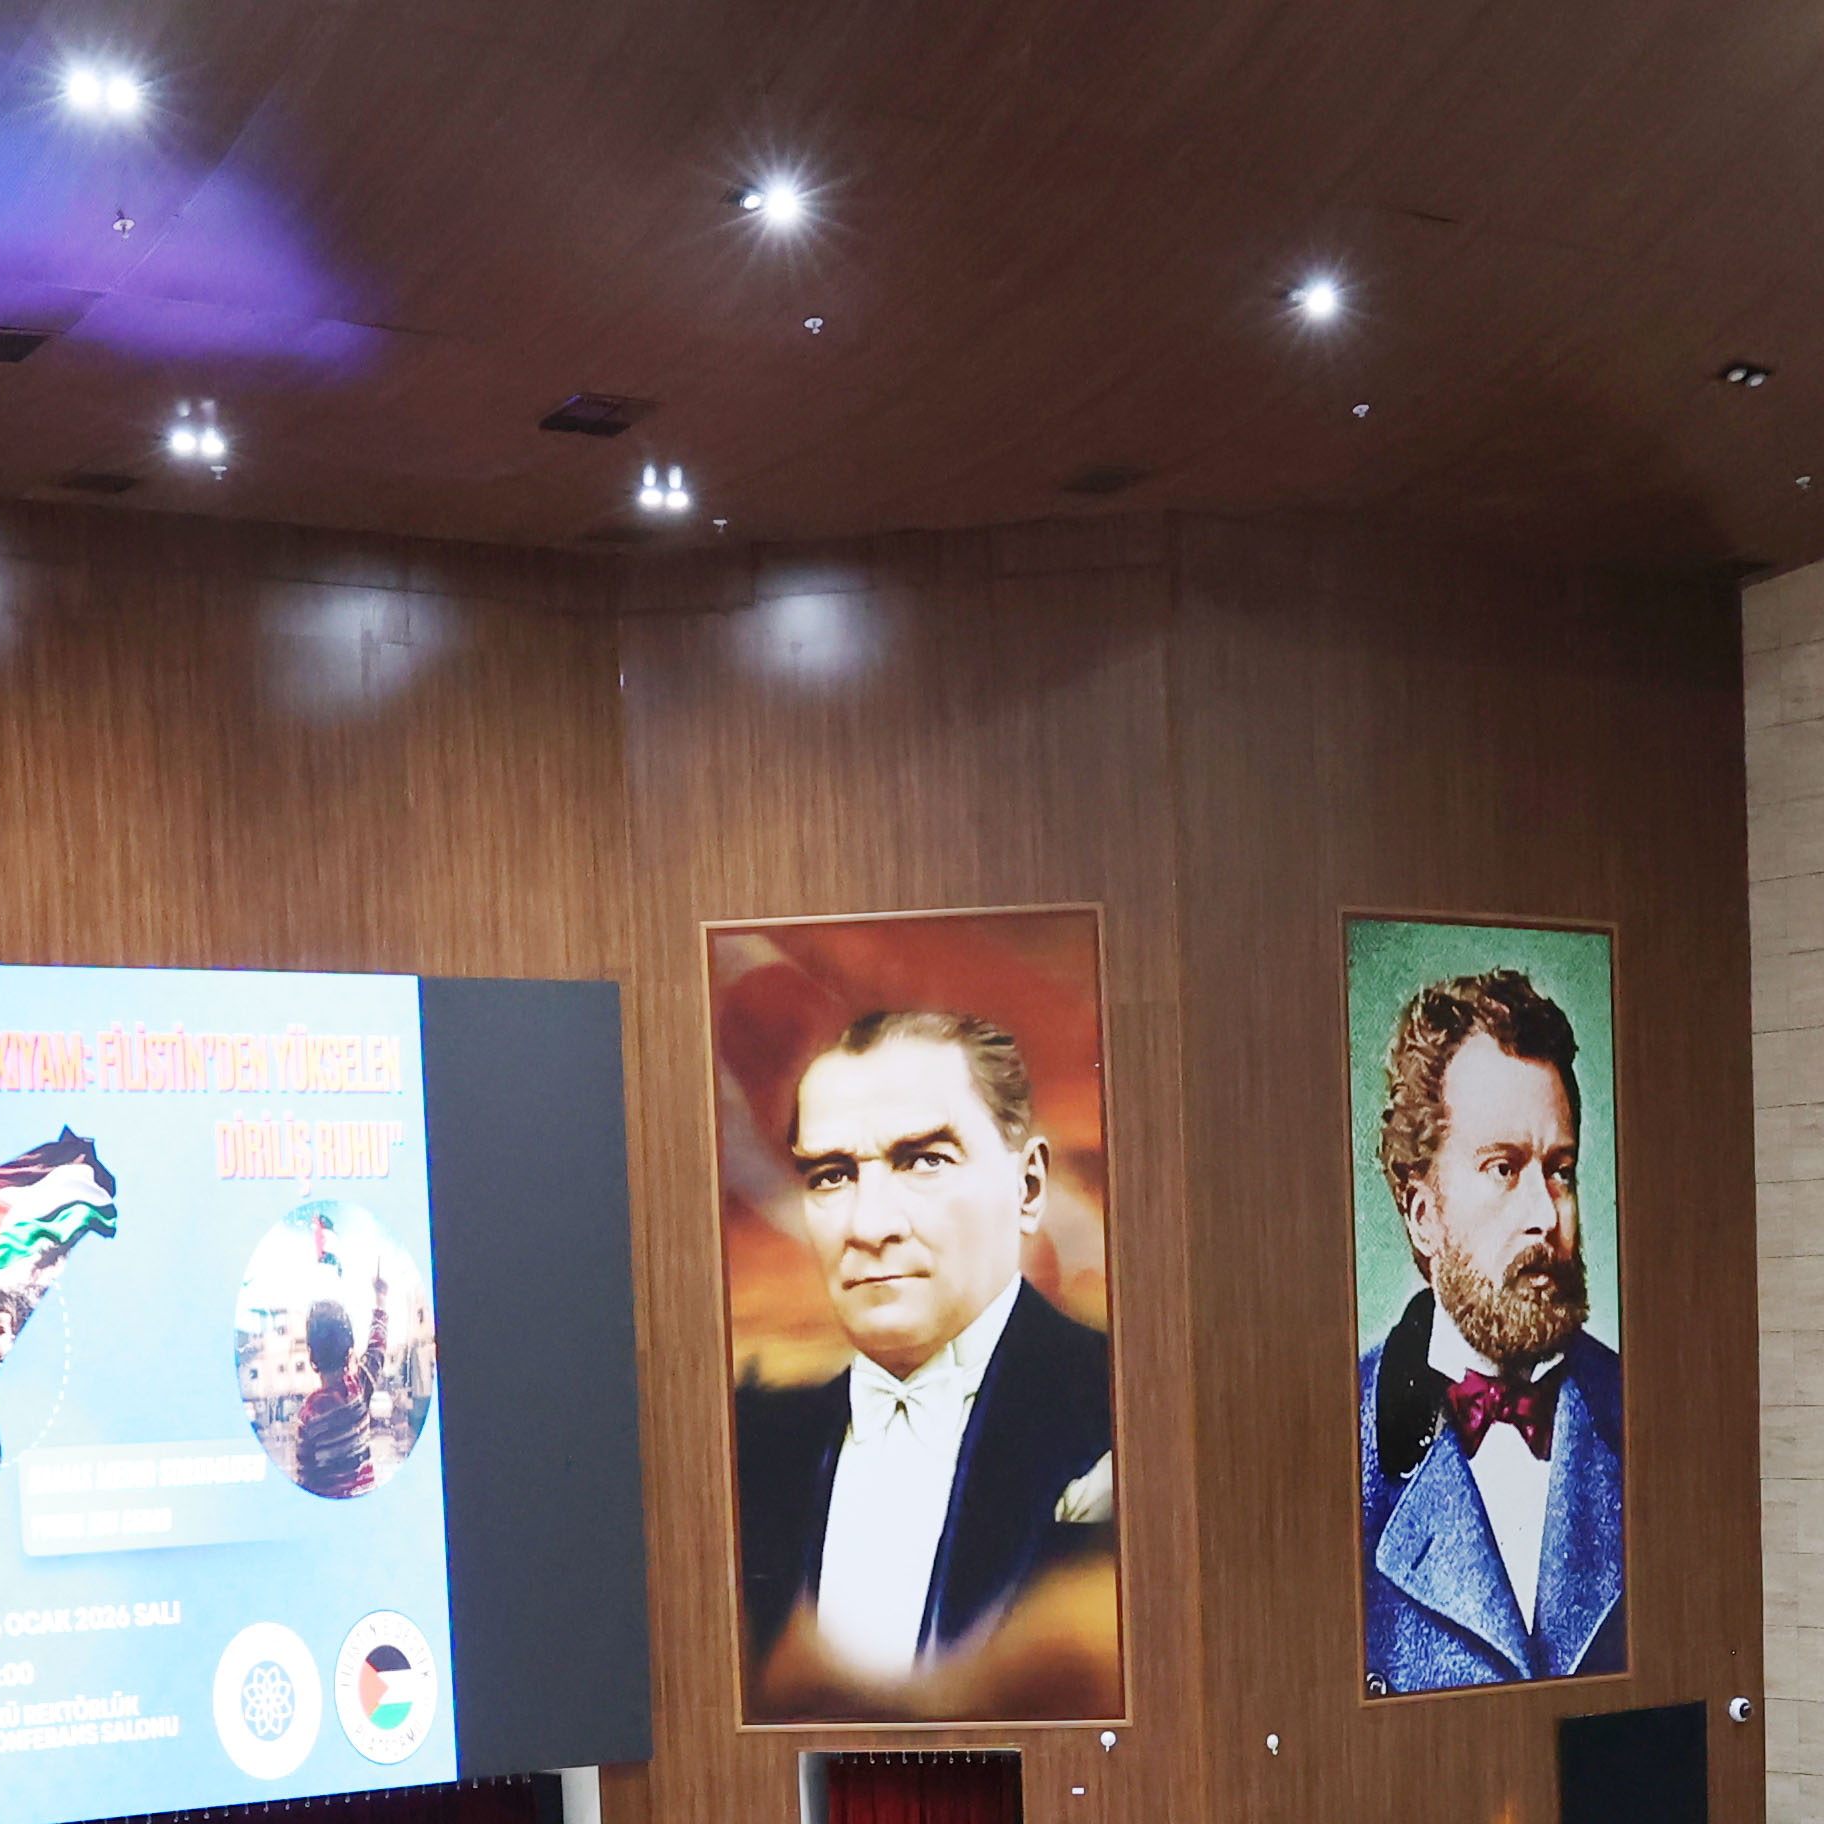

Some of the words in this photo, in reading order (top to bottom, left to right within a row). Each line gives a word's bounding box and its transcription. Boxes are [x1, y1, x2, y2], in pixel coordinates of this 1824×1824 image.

[271, 1024, 403, 1094] YÜKSELEN
[215, 1110, 312, 1197] DİRİLİŞ
[4, 1608, 72, 1637] OCAK
[74, 1605, 130, 1631] 2026
[100, 1716, 179, 1743] SALONU
